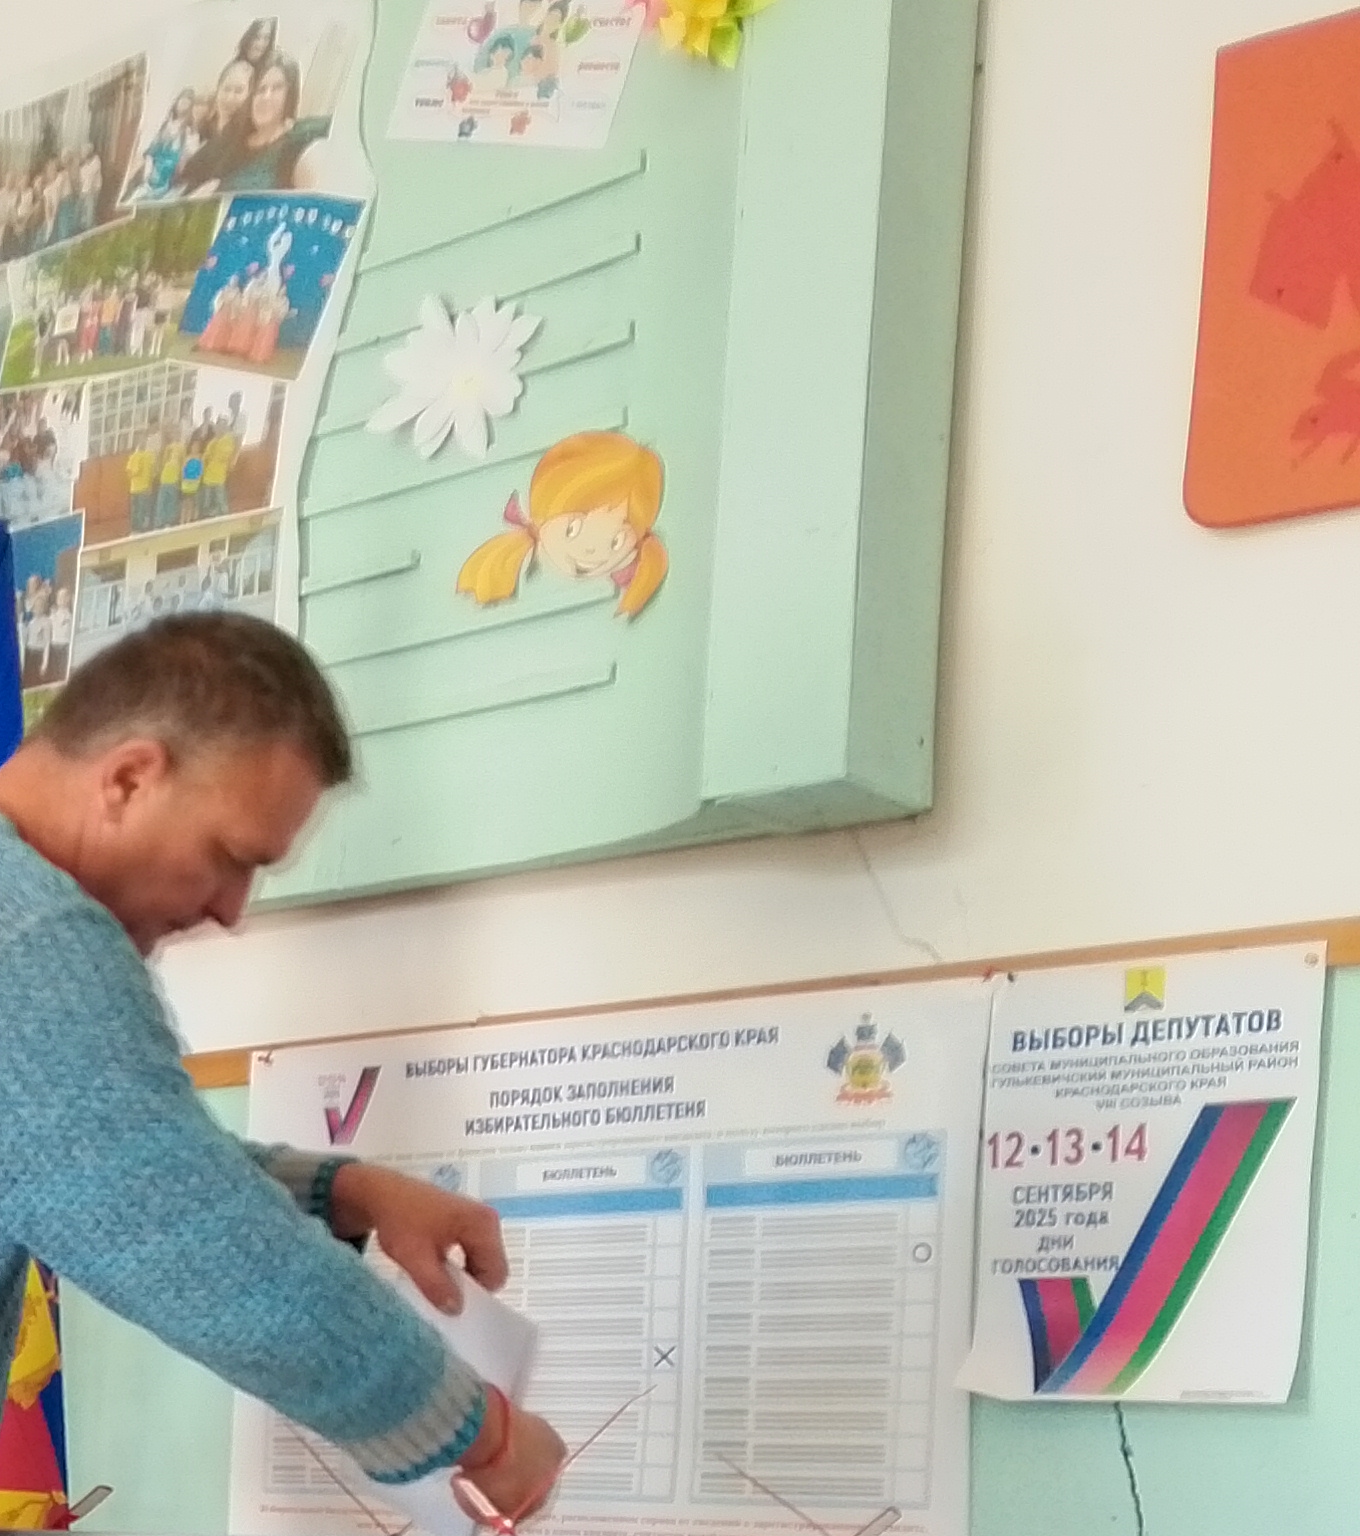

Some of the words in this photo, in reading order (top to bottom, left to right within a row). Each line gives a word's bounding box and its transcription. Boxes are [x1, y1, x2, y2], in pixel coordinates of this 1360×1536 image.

[1012, 1020, 1124, 1053] ВЫБОРЫ
[1131, 1008, 1283, 1046] ДЕПУТАТОВ
[405, 1054, 469, 1079] ВЫБОРЫ
[473, 1045, 577, 1072] ГУБЕРНАТОРА
[581, 1029, 730, 1061] КРАСНОДАРСКОГО
[734, 1025, 780, 1048] КРАЯ
[1050, 1050, 1186, 1071] МУНИЦИПАЛЬНОГО
[1188, 1040, 1300, 1060] ОБРАЗОВАНИЯ
[1110, 1058, 1245, 1081] МУНИЦИПАЛЬНЫЙ
[1248, 1055, 1299, 1072] РАЙОН
[489, 1084, 563, 1109] ПОРЯДОК
[566, 1075, 675, 1101] ЗАПОЛНЕНИЯ
[1055, 1080, 1186, 1098] КРАСНОДАРСКОГО
[1189, 1075, 1228, 1089] КРАЯ
[465, 1108, 601, 1137] ИЗБИРАТЕЛЬНОГО
[605, 1099, 707, 1125] БЮЛЛЕТЕНЯ
[1012, 1181, 1114, 1205] СЕНТЯБРЯ
[1014, 1208, 1059, 1228] 2025
[1064, 1210, 1110, 1228] года
[1037, 1234, 1075, 1253] ДНИ
[991, 1254, 1121, 1276] ГОЛОСОВАНИЯ
